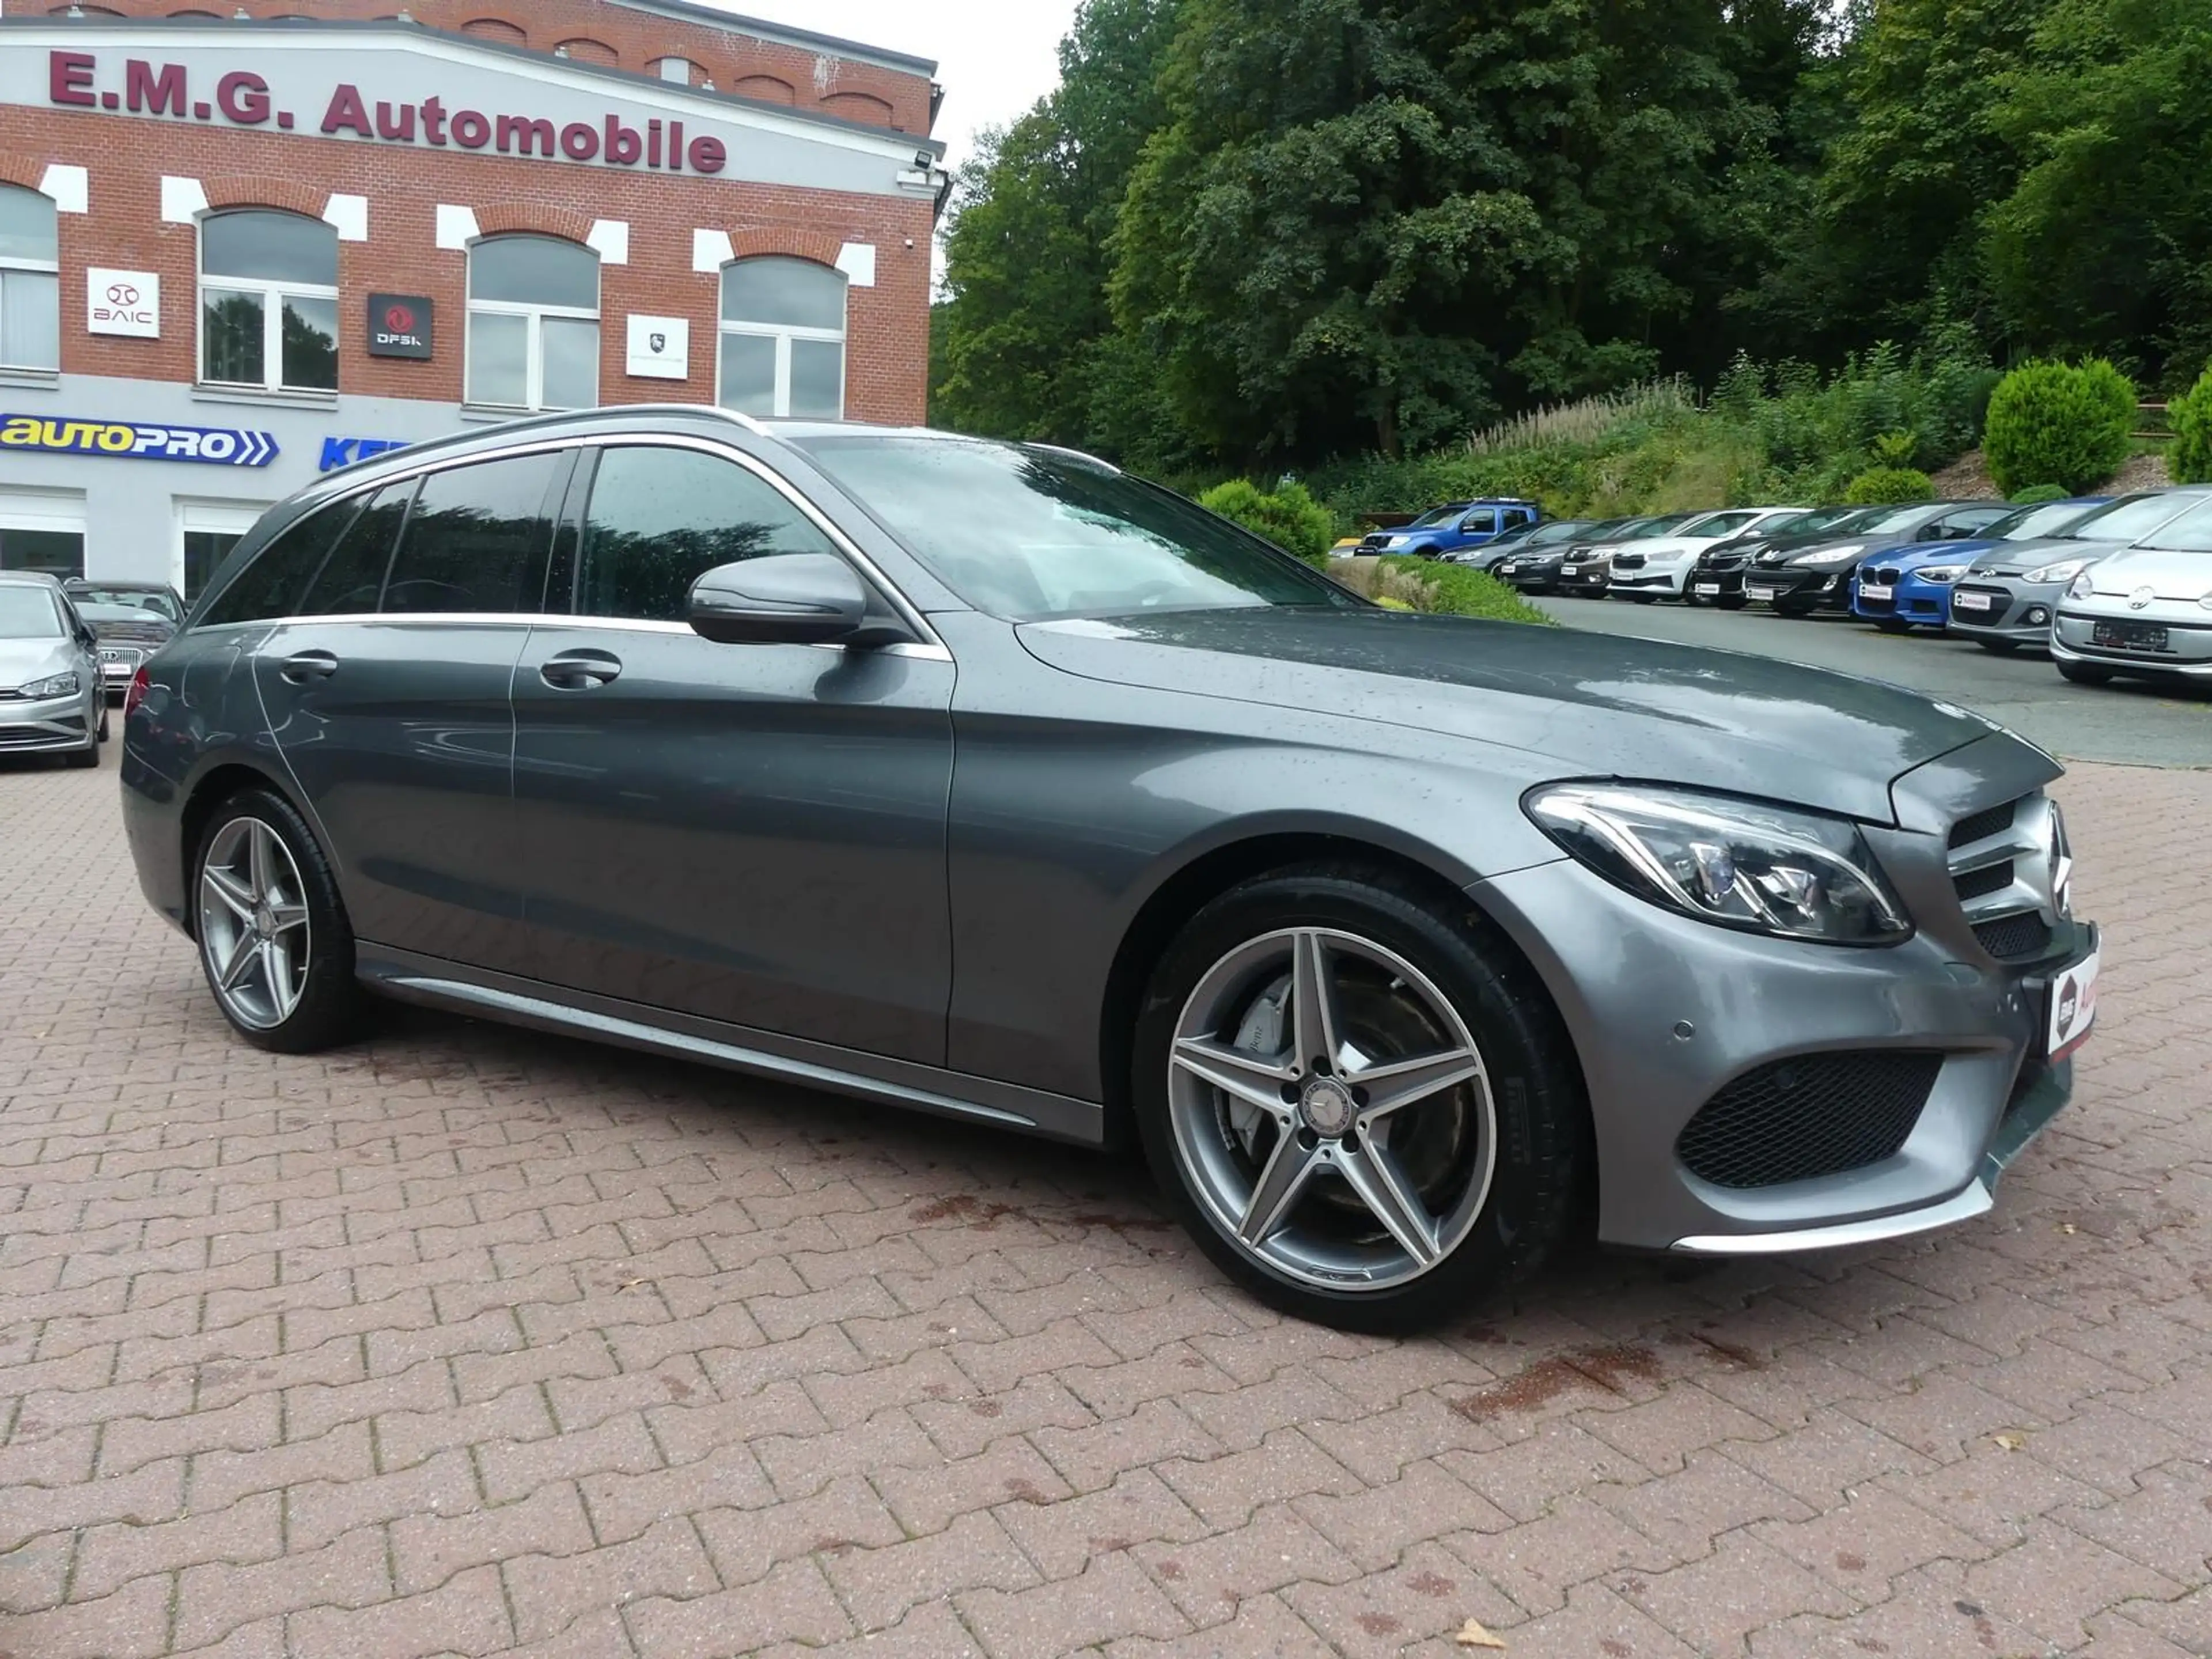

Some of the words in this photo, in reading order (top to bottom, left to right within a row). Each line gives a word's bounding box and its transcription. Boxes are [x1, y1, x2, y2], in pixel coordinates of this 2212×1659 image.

[50, 50, 294, 128] E.M.G.
[320, 84, 726, 172] Automobile
[93, 308, 153, 324] BAIC
